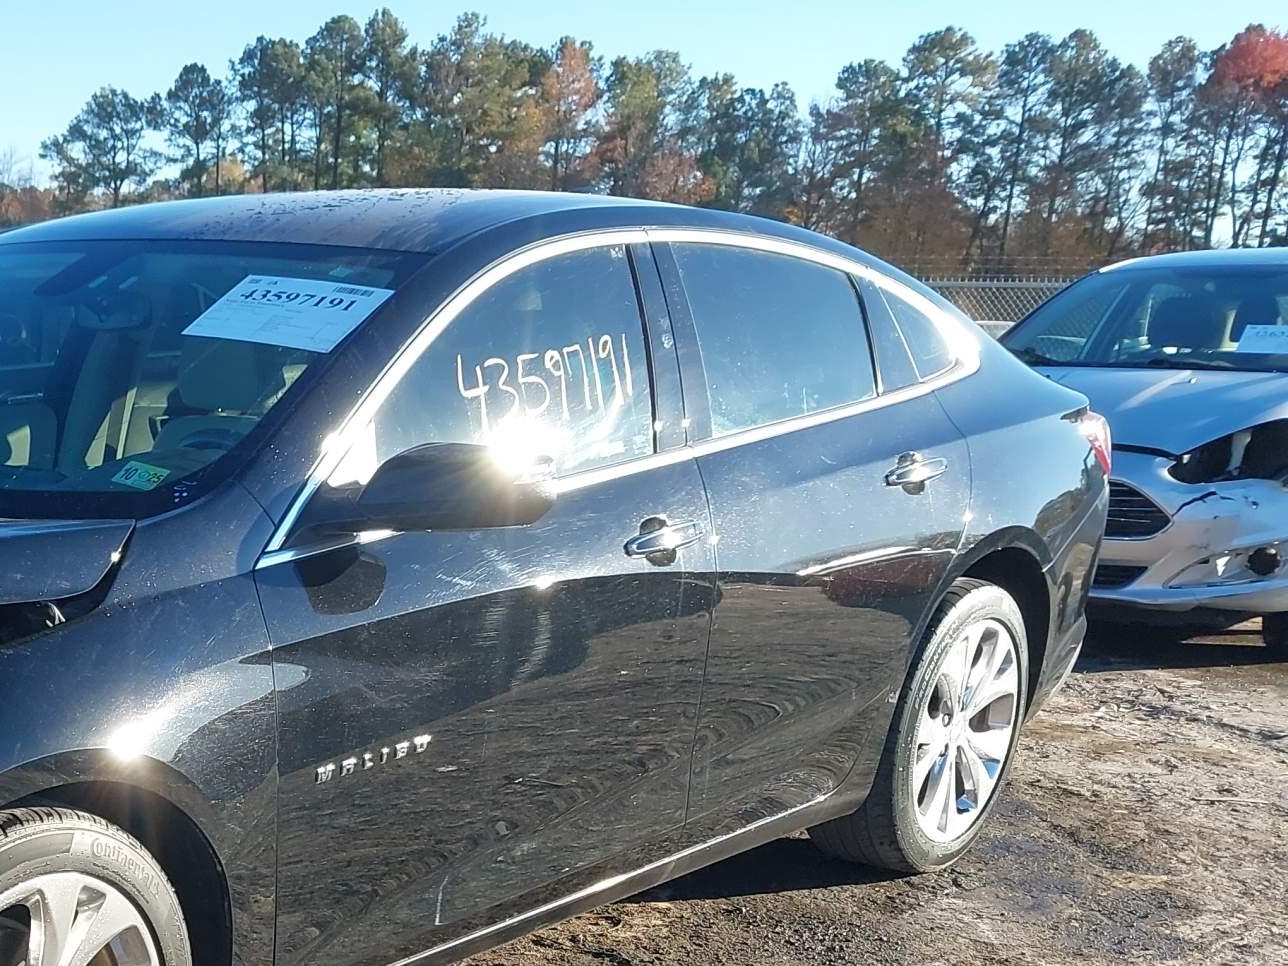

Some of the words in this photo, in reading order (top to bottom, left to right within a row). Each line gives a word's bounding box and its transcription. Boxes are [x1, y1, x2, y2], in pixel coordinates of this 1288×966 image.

[239, 288, 359, 312] 43597191
[456, 332, 634, 433] 43597191
[119, 466, 140, 481] 10
